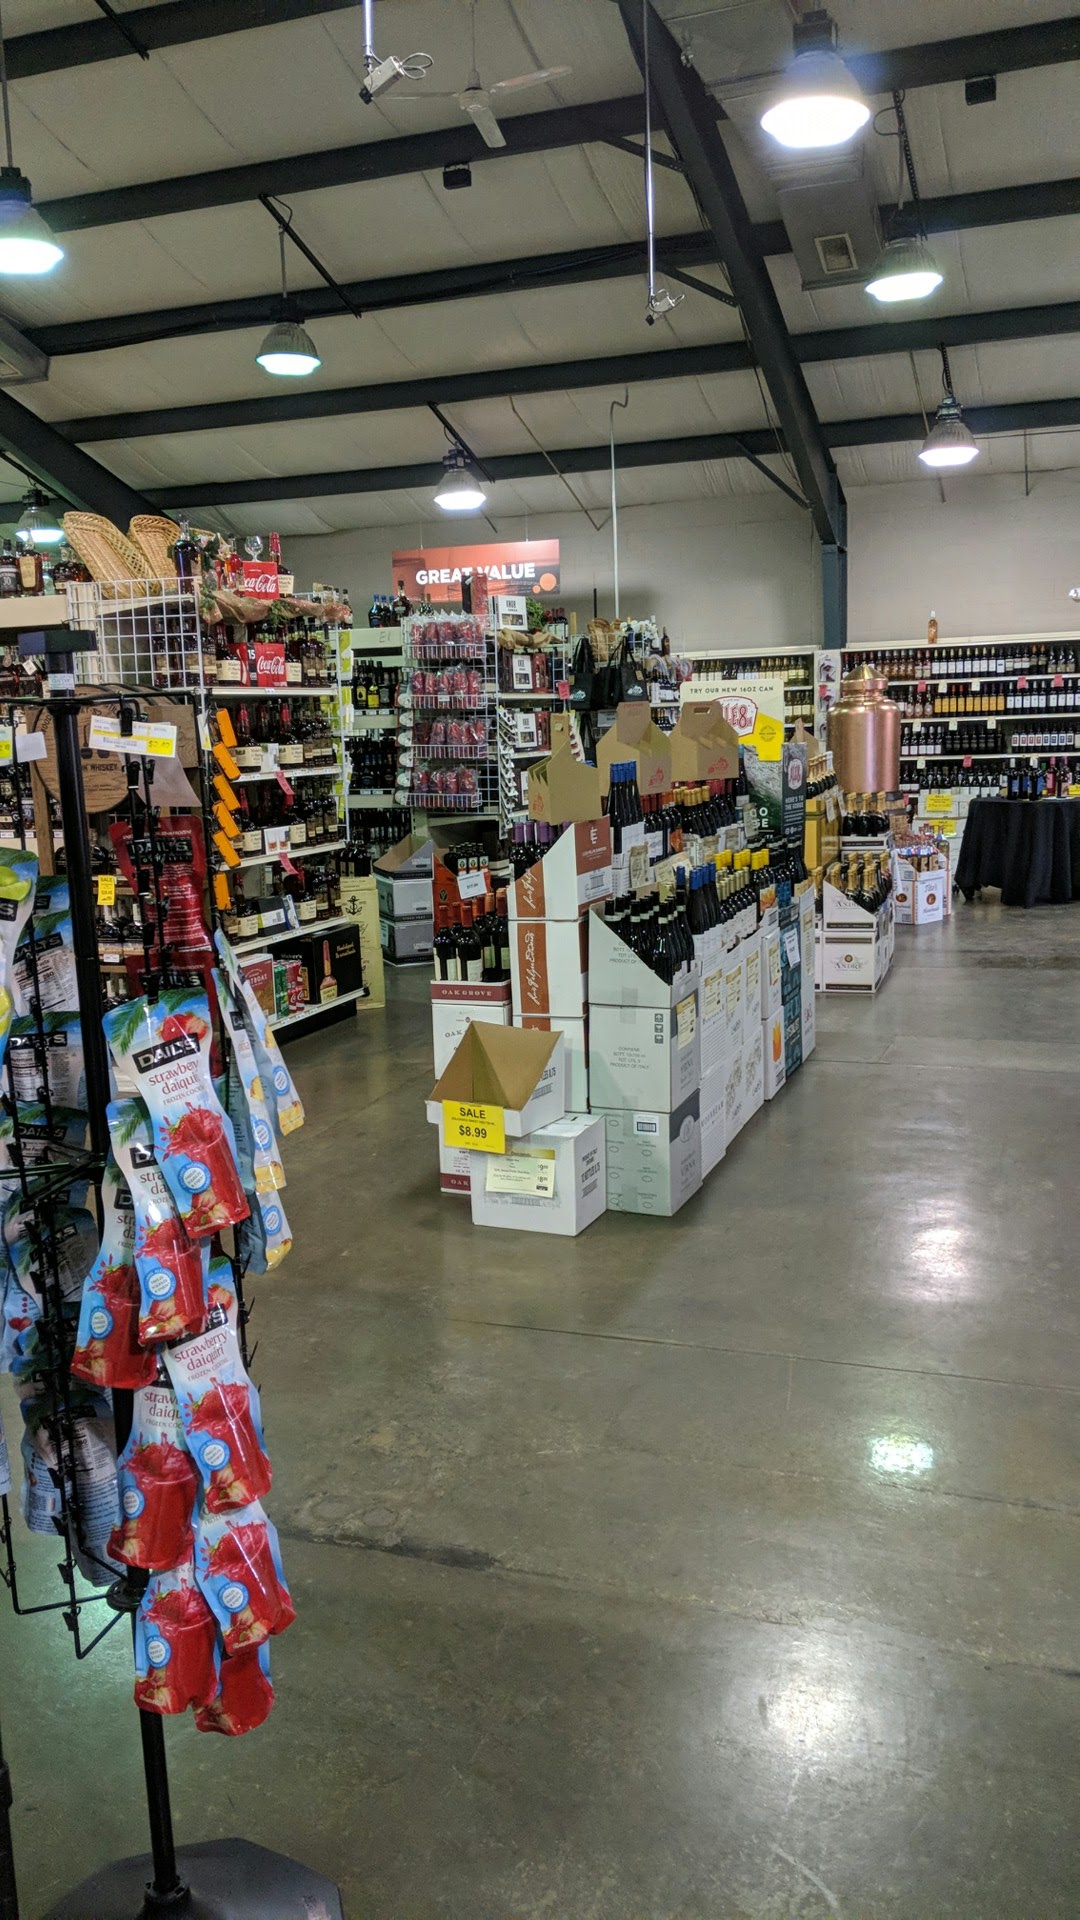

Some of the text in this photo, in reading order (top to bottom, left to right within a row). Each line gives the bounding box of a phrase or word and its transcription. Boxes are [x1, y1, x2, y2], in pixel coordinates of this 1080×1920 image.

[415, 562, 535, 585] GREAT VALUE
[244, 574, 278, 593] ca-Cola
[247, 650, 256, 660] 15
[256, 654, 285, 675] Coca-Cola
[445, 1030, 462, 1038] OAK
[459, 1107, 486, 1120] SALE
[458, 1125, 487, 1139] $8.99
[174, 1331, 228, 1363] strawberry
[186, 1345, 225, 1371] daiquiri
